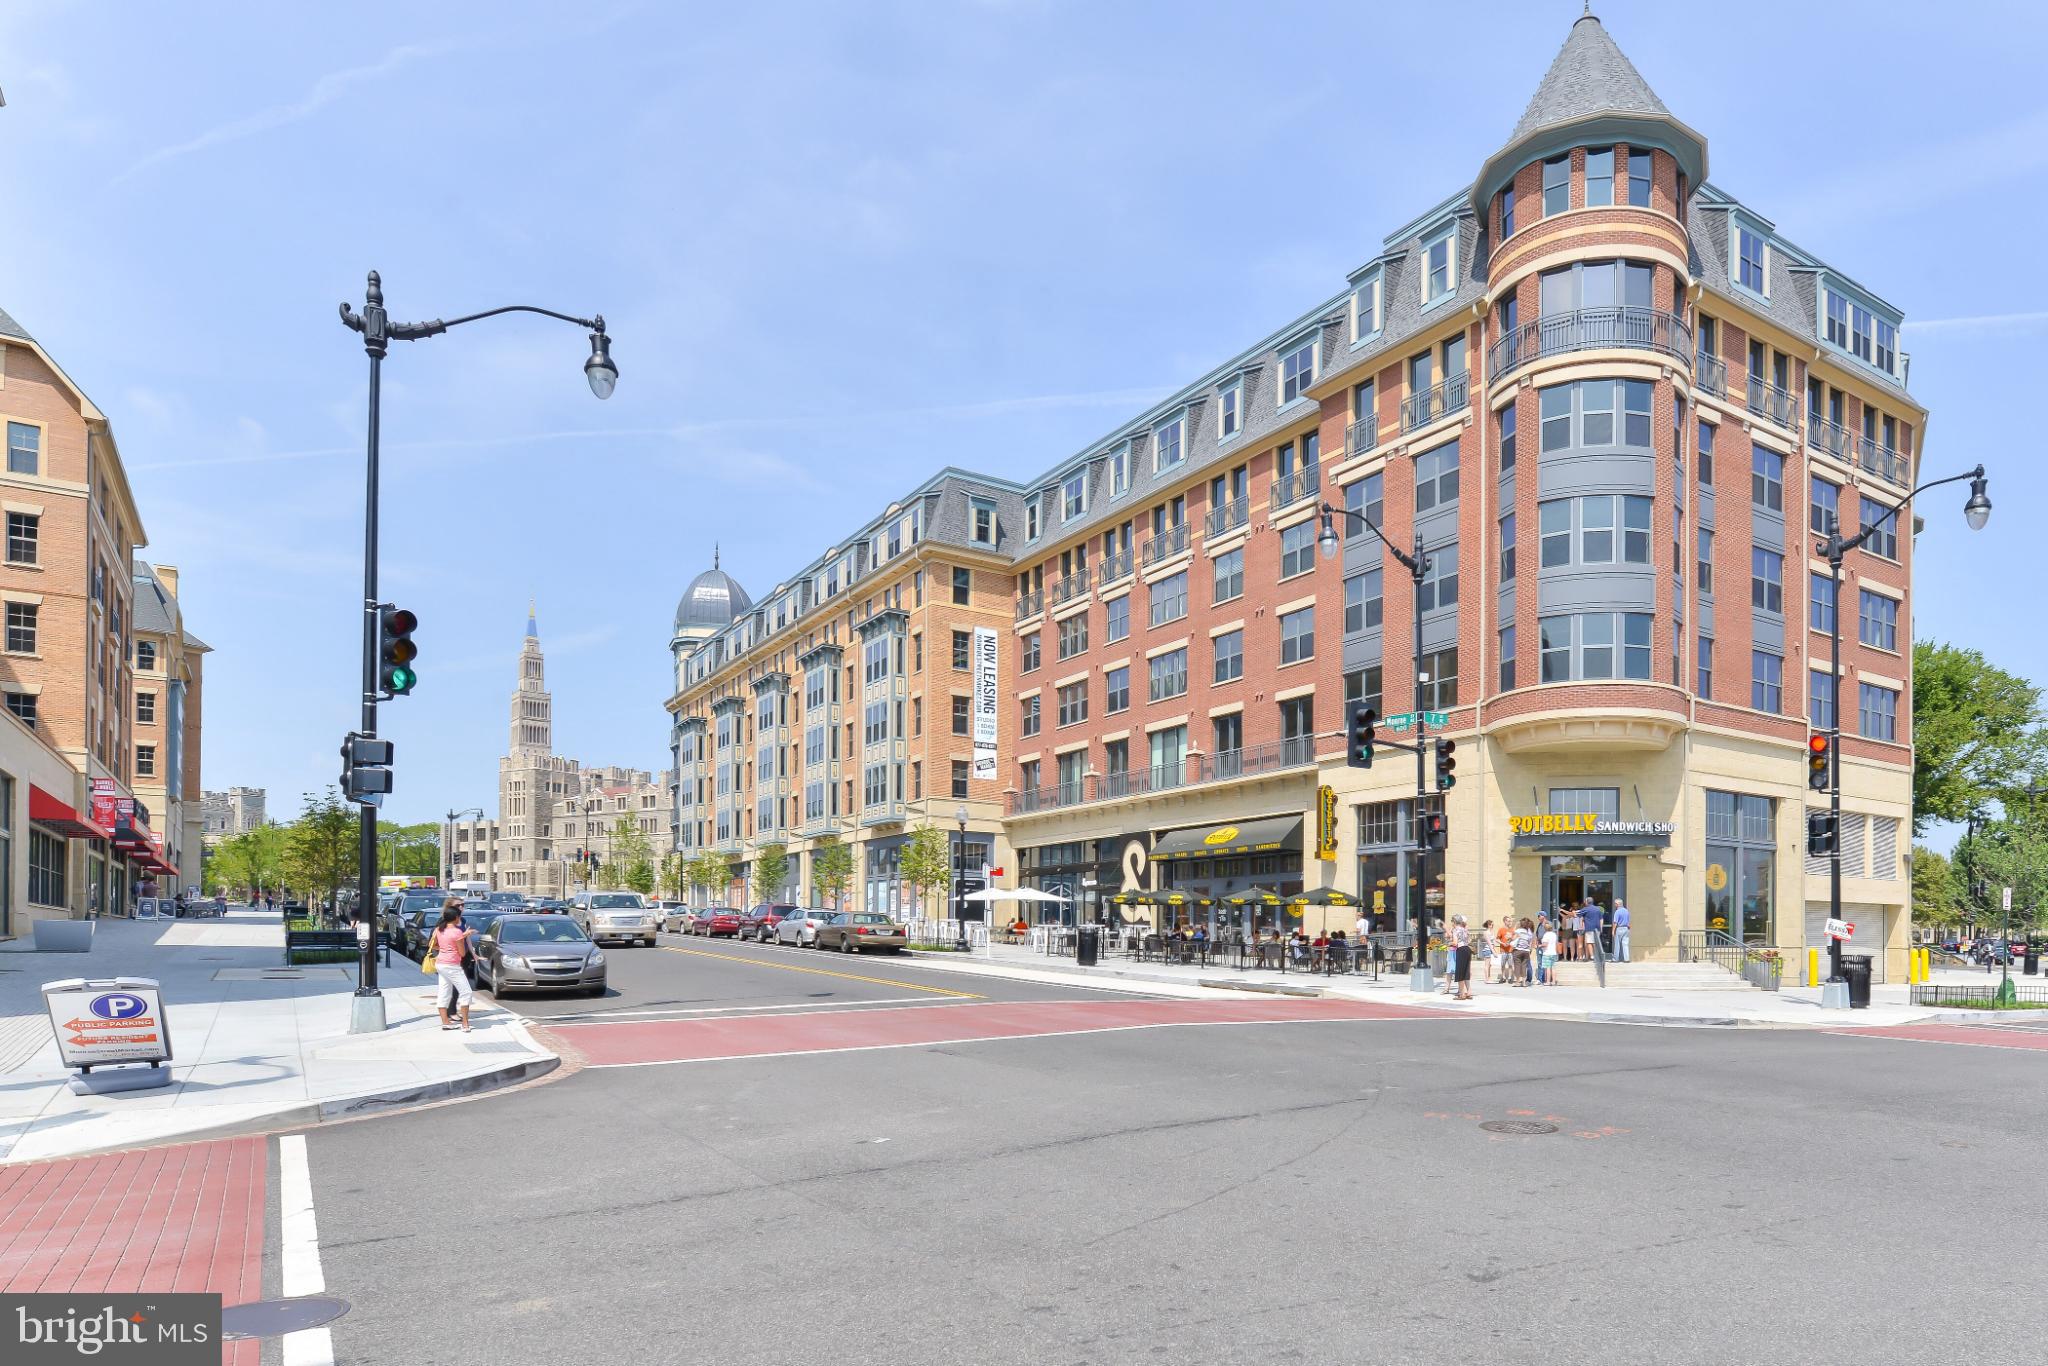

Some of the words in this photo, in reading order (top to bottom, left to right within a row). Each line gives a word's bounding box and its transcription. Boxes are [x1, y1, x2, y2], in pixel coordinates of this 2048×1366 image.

[983, 636, 996, 664] NOW
[983, 666, 996, 714] LEASING
[1386, 717, 1407, 726] Monroe
[1431, 714, 1435, 722] 7
[1509, 815, 1598, 833] POTBELLY
[1597, 821, 1651, 832] SANDWICH
[108, 998, 134, 1017] P
[109, 1019, 152, 1027] PARKING
